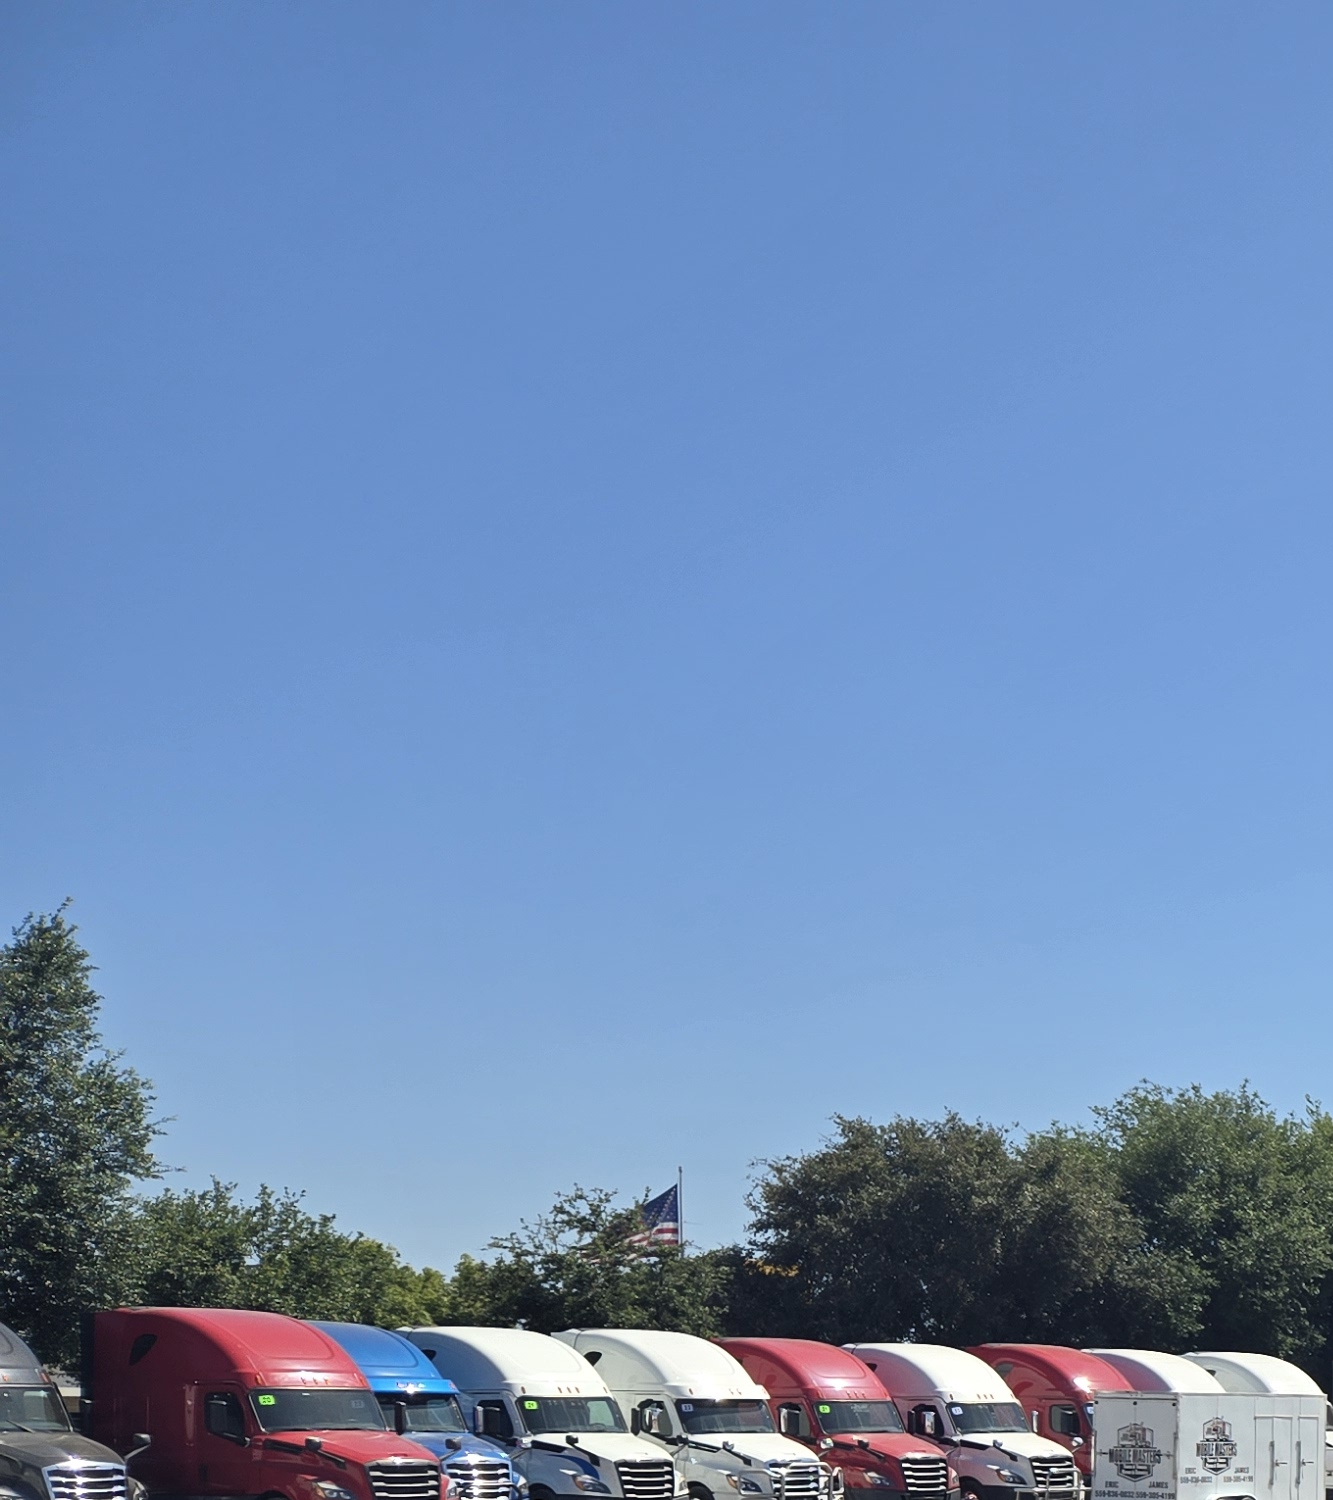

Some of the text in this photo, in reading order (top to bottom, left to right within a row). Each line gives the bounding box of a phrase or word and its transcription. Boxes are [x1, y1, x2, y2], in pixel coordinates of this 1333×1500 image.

[1196, 1443, 1214, 1457] MOBILE
[1109, 1448, 1161, 1464] MOBILE MASTERS
[1105, 1481, 1119, 1489] ERIC
[1149, 1481, 1169, 1489] JAMES
